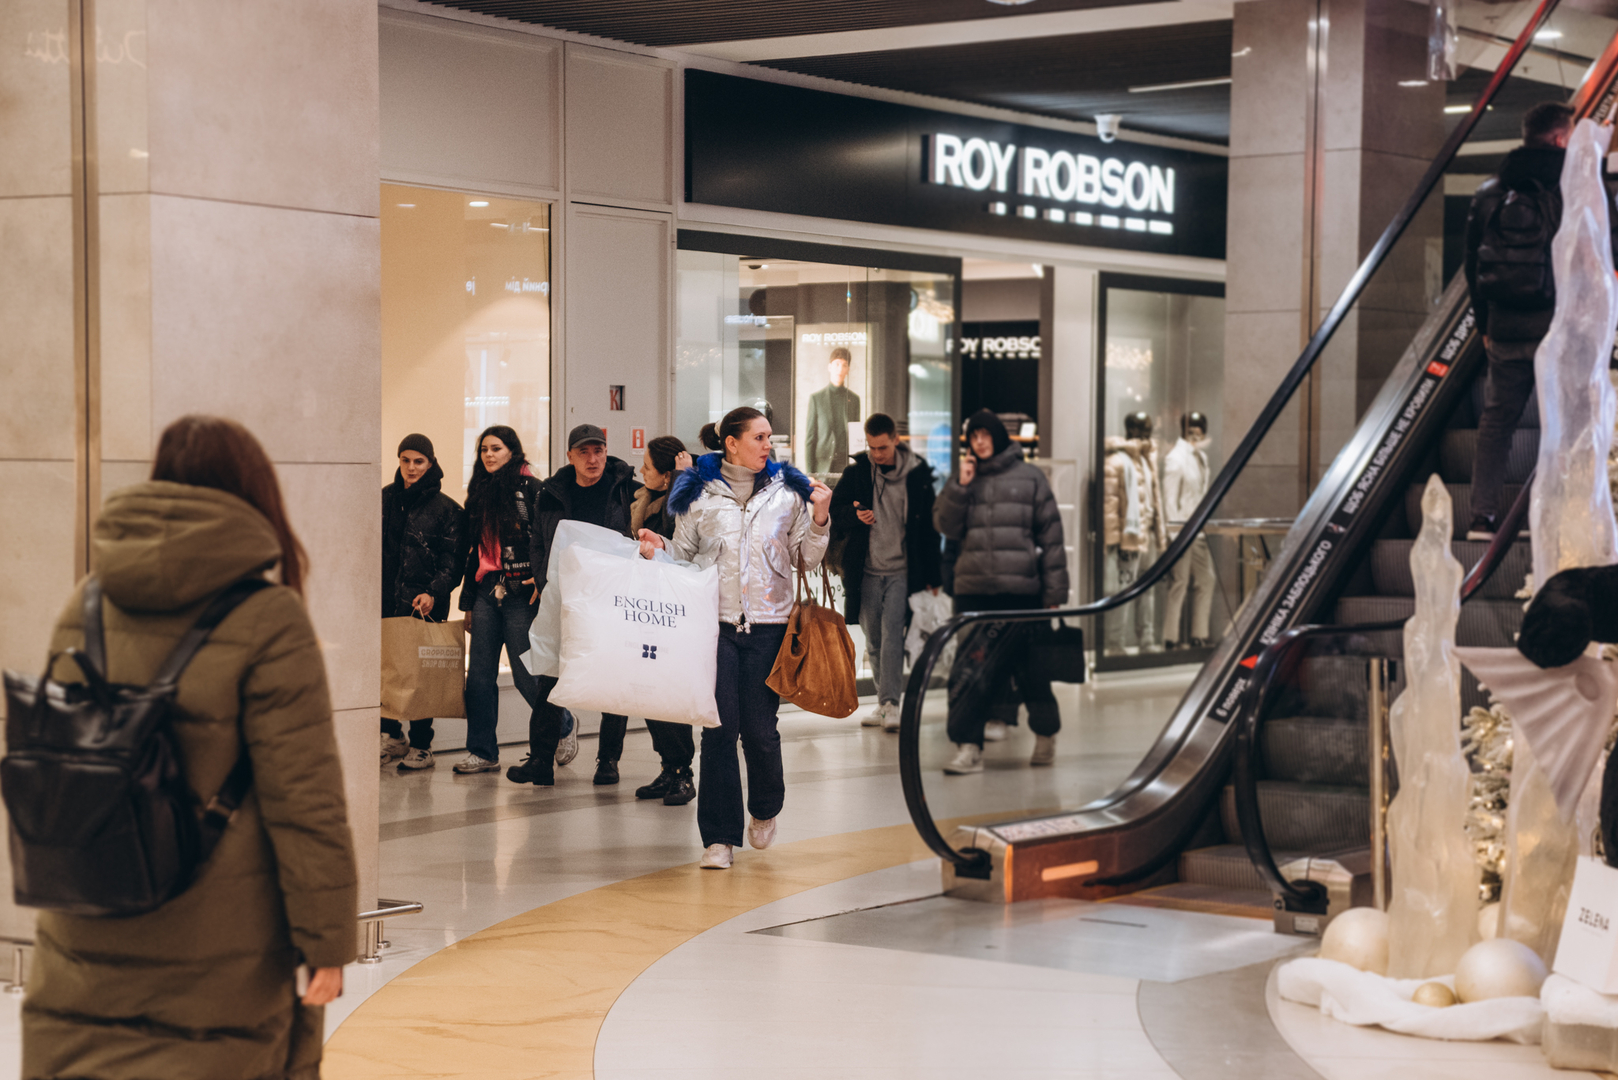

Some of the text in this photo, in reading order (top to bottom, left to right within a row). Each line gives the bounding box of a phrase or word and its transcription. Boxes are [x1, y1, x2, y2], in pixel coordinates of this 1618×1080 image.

[933, 133, 1175, 214] ROY ROBSON
[802, 332, 867, 343] ROY ROBSON
[982, 336, 1041, 353] ROBSO
[613, 595, 686, 617] ENGLISH
[624, 609, 677, 628] HOME
[1579, 907, 1609, 931] ZELENA
